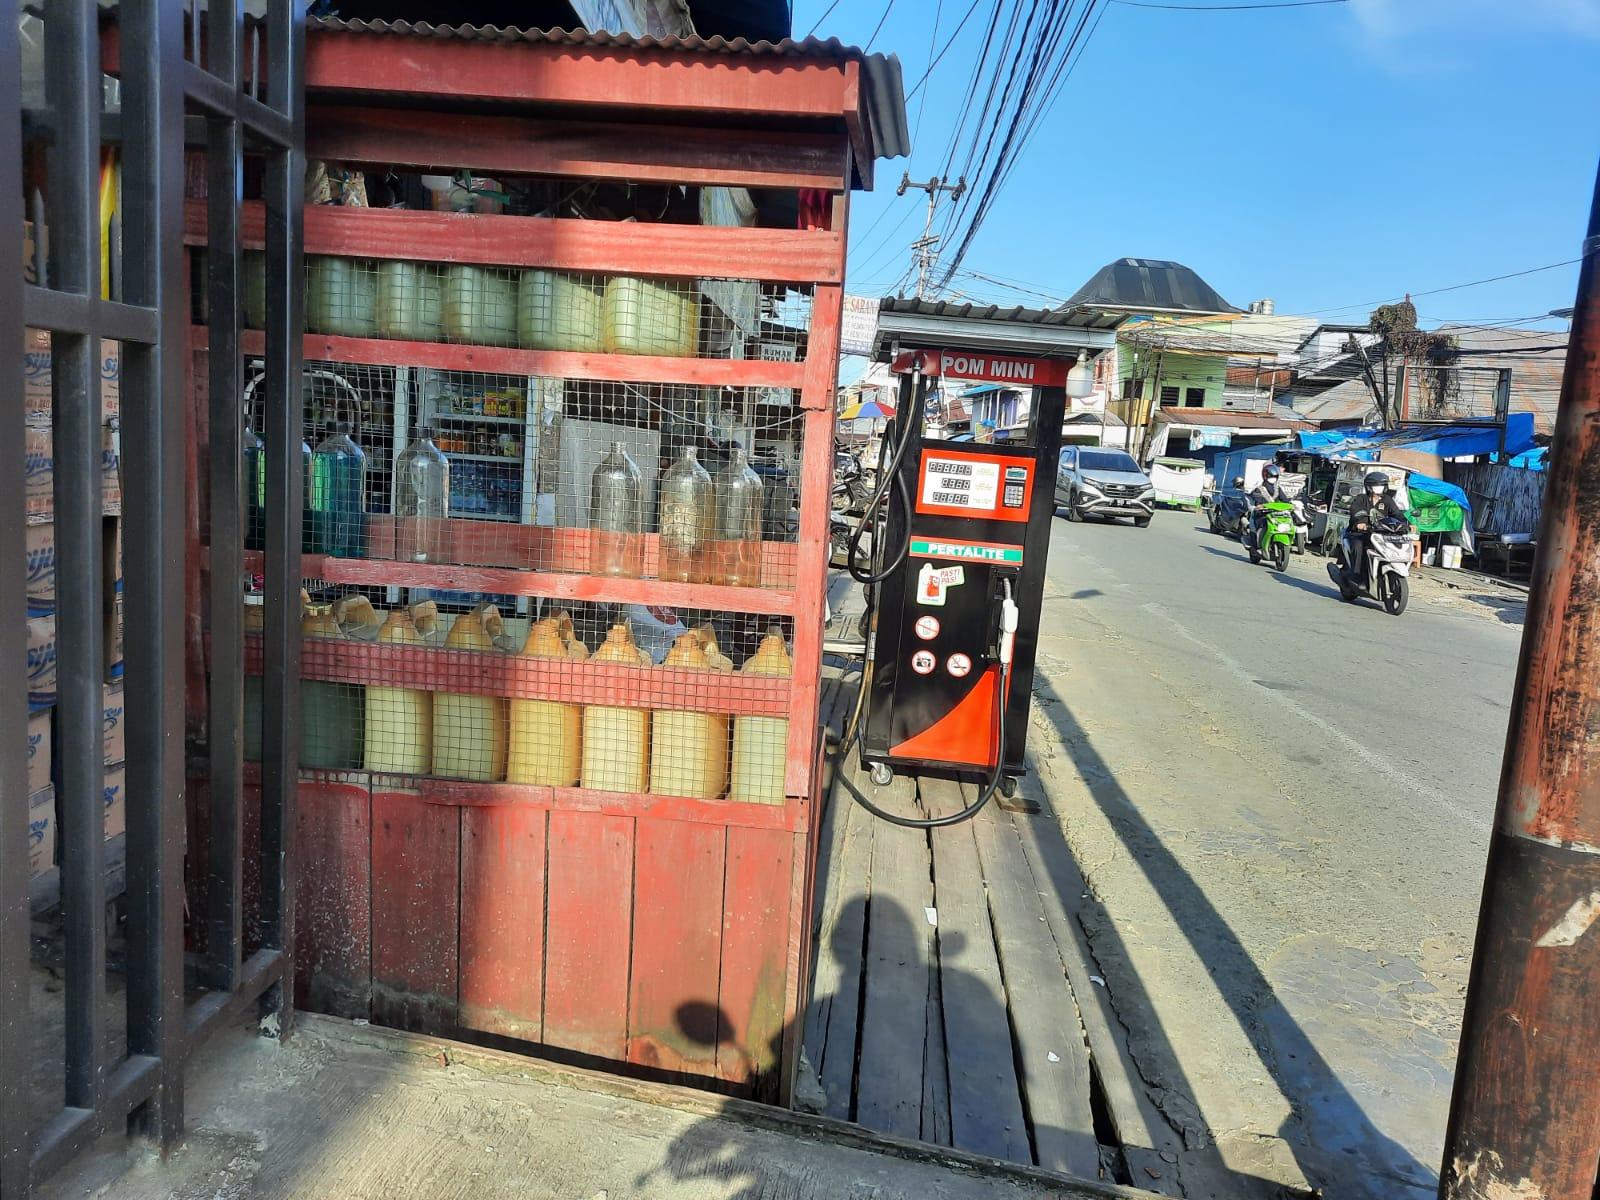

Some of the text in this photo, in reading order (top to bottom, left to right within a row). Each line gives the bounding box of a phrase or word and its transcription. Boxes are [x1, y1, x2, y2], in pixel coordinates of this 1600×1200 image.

[942, 356, 1036, 380] POM MINI
[927, 543, 1005, 560] PERTALITE
